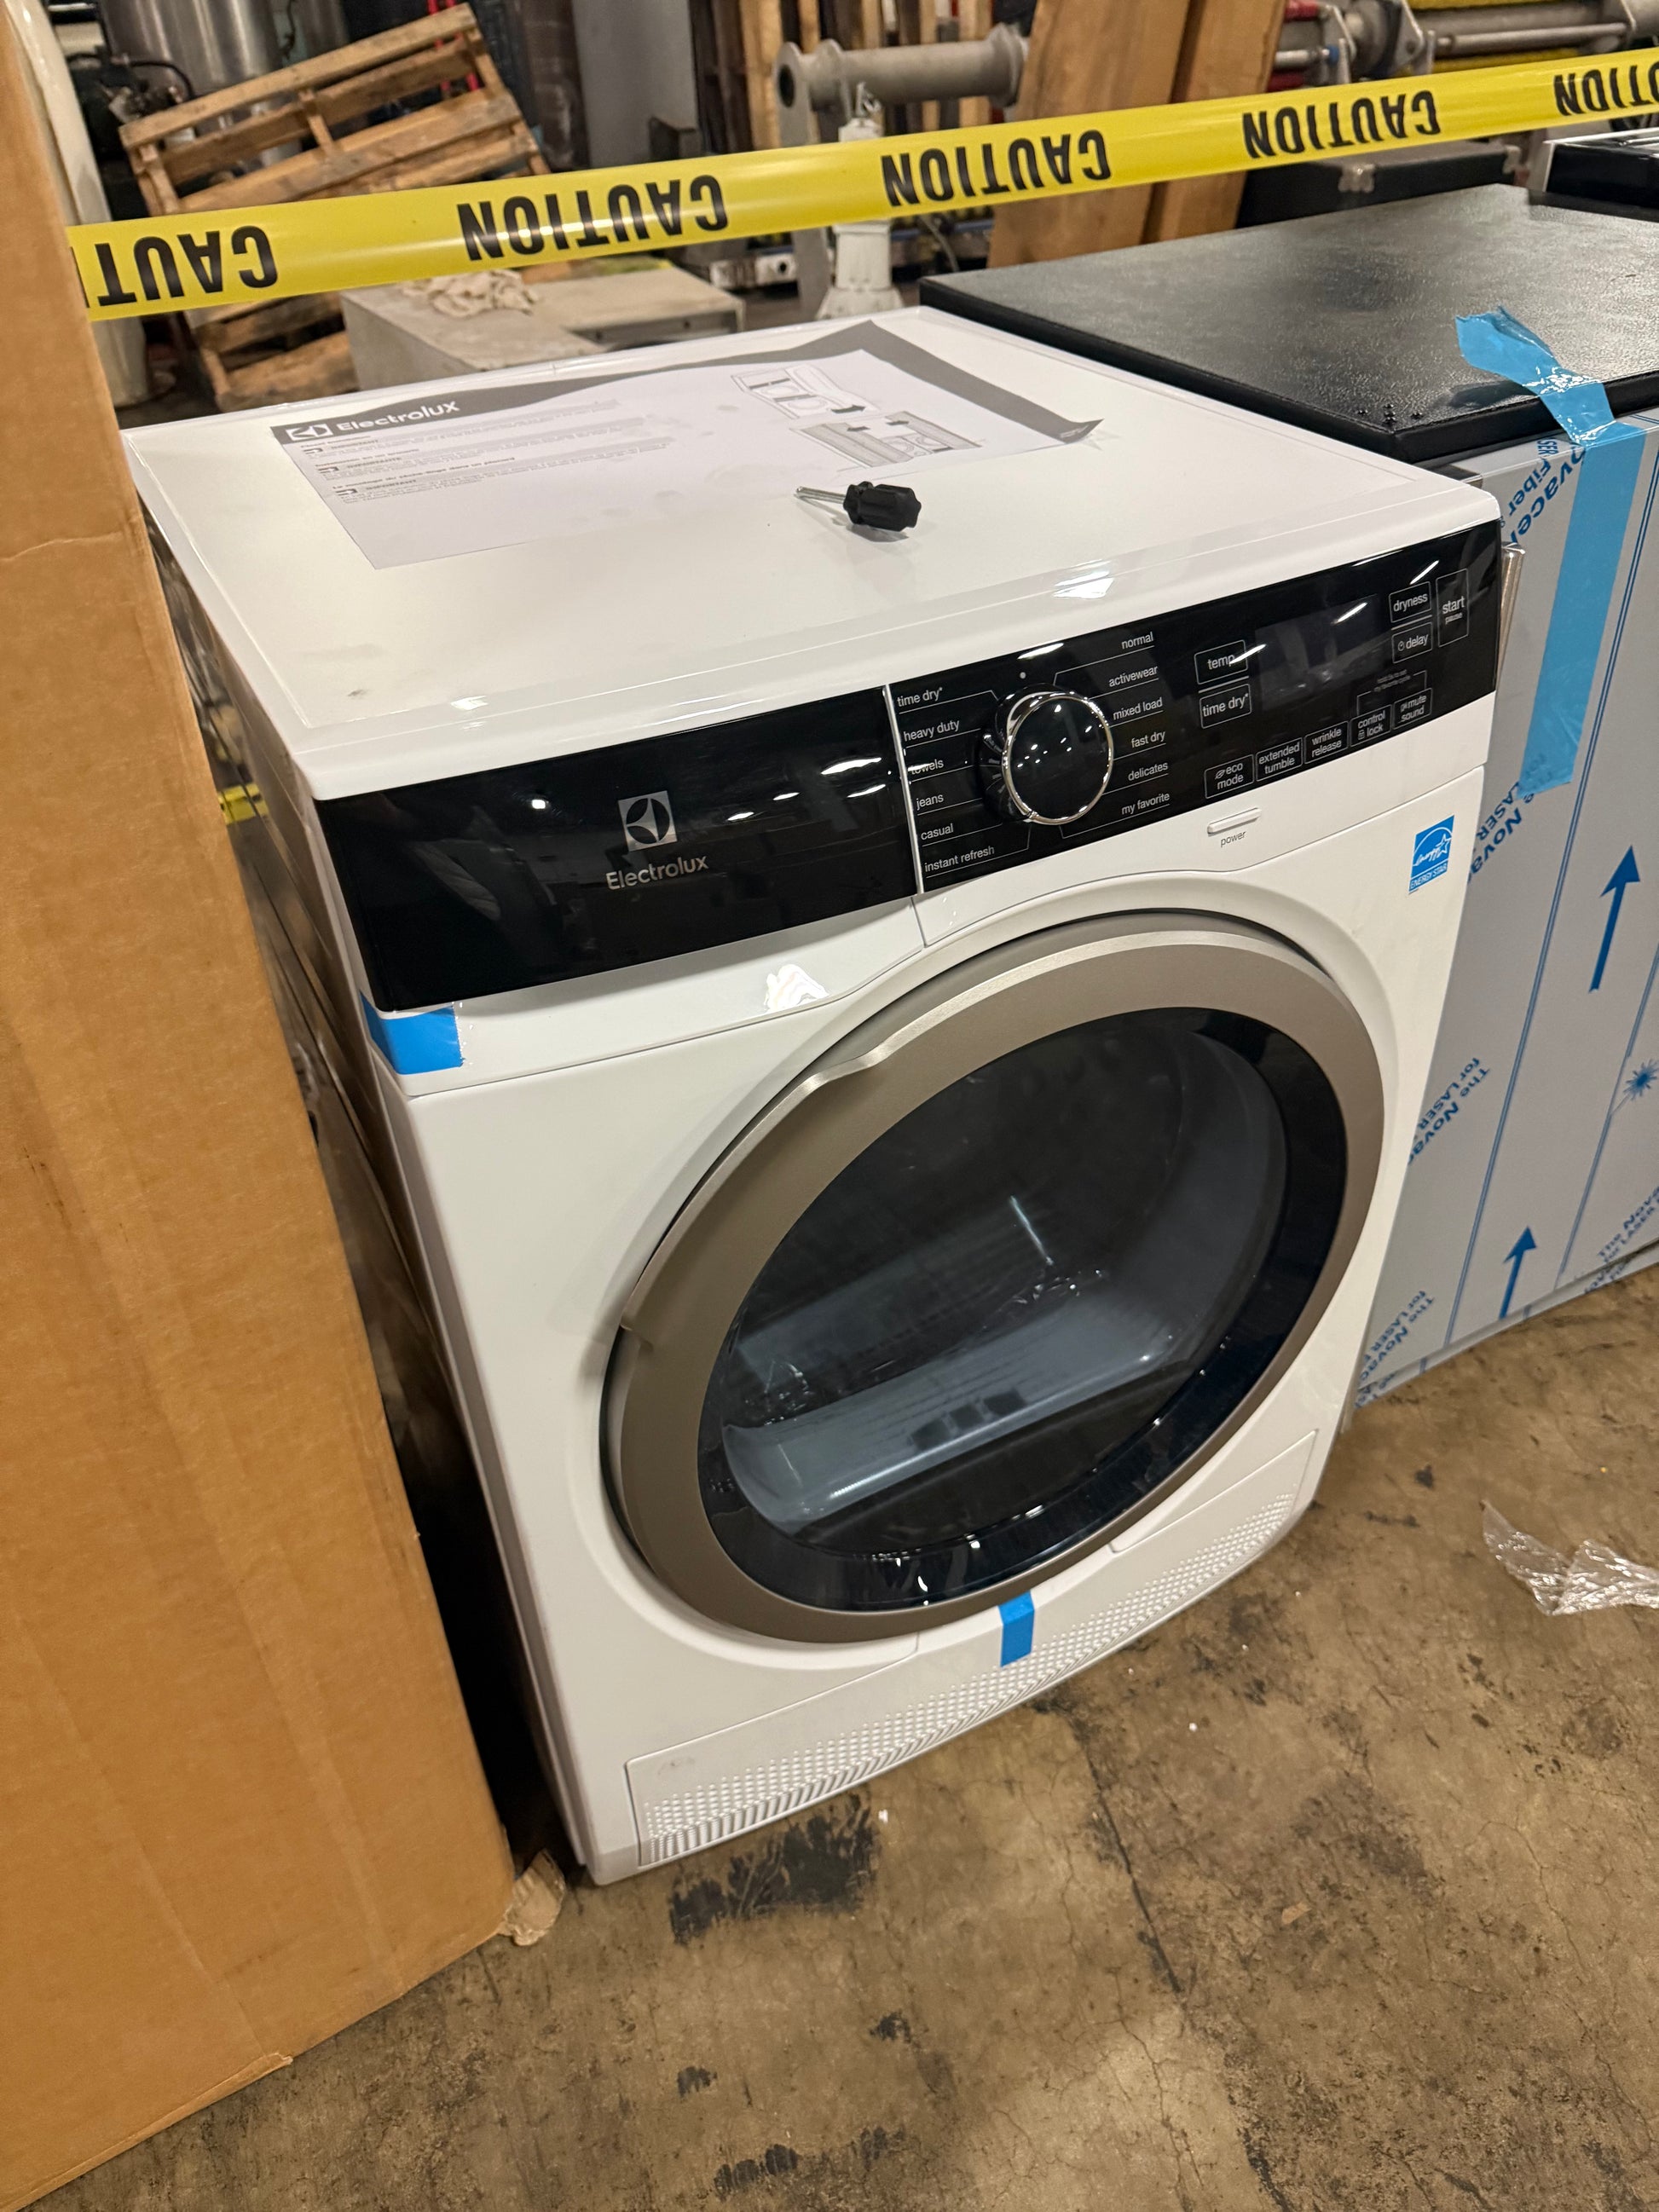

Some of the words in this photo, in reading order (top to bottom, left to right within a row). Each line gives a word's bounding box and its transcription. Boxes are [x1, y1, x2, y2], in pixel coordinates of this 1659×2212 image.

[1242, 90, 1441, 159] CAUTION
[881, 130, 1111, 207] CAUTION
[456, 174, 729, 261] CAUTION
[71, 225, 279, 309] CAUT
[337, 401, 460, 431] Electrolux
[1508, 458, 1551, 517] Fiber
[1511, 442, 1586, 543] ovacel
[1393, 593, 1428, 612] dryness
[1442, 596, 1465, 615] start
[1121, 632, 1153, 650] normal
[1406, 634, 1429, 650] delay
[1207, 654, 1235, 670] temp
[1108, 666, 1159, 687] activewear
[898, 695, 921, 707] time
[1113, 704, 1142, 720] mixed
[1142, 697, 1163, 713] load
[1202, 702, 1226, 718] time
[1408, 695, 1427, 709] mute
[1358, 710, 1385, 729] control
[1402, 705, 1425, 721] sound
[904, 727, 935, 742] heavy
[937, 720, 960, 736] duty
[1312, 728, 1342, 745] wrinkle
[1367, 723, 1383, 736] lock
[1131, 734, 1149, 748] fast
[1150, 731, 1165, 745] dry
[1312, 740, 1342, 757] release
[1259, 742, 1300, 765] extended
[1128, 762, 1168, 782] delicates
[1226, 763, 1243, 775] eco
[1264, 757, 1295, 774] tumble
[1217, 774, 1244, 790] mode
[916, 794, 945, 810] jeans
[1121, 802, 1136, 816] my
[1137, 793, 1171, 811] favorite
[921, 823, 954, 840] casual
[1220, 831, 1246, 847] power
[1468, 807, 1522, 883] Nova
[924, 855, 958, 872] instant
[961, 846, 995, 863] refresh
[605, 855, 709, 890] Electrolux
[1410, 872, 1432, 890] ENERGY
[1459, 1058, 1480, 1081] for
[1460, 1068, 1489, 1097] The
[1418, 1082, 1460, 1129] LASER
[1408, 1297, 1435, 1323] The
[1360, 1326, 1408, 1381] Novac
